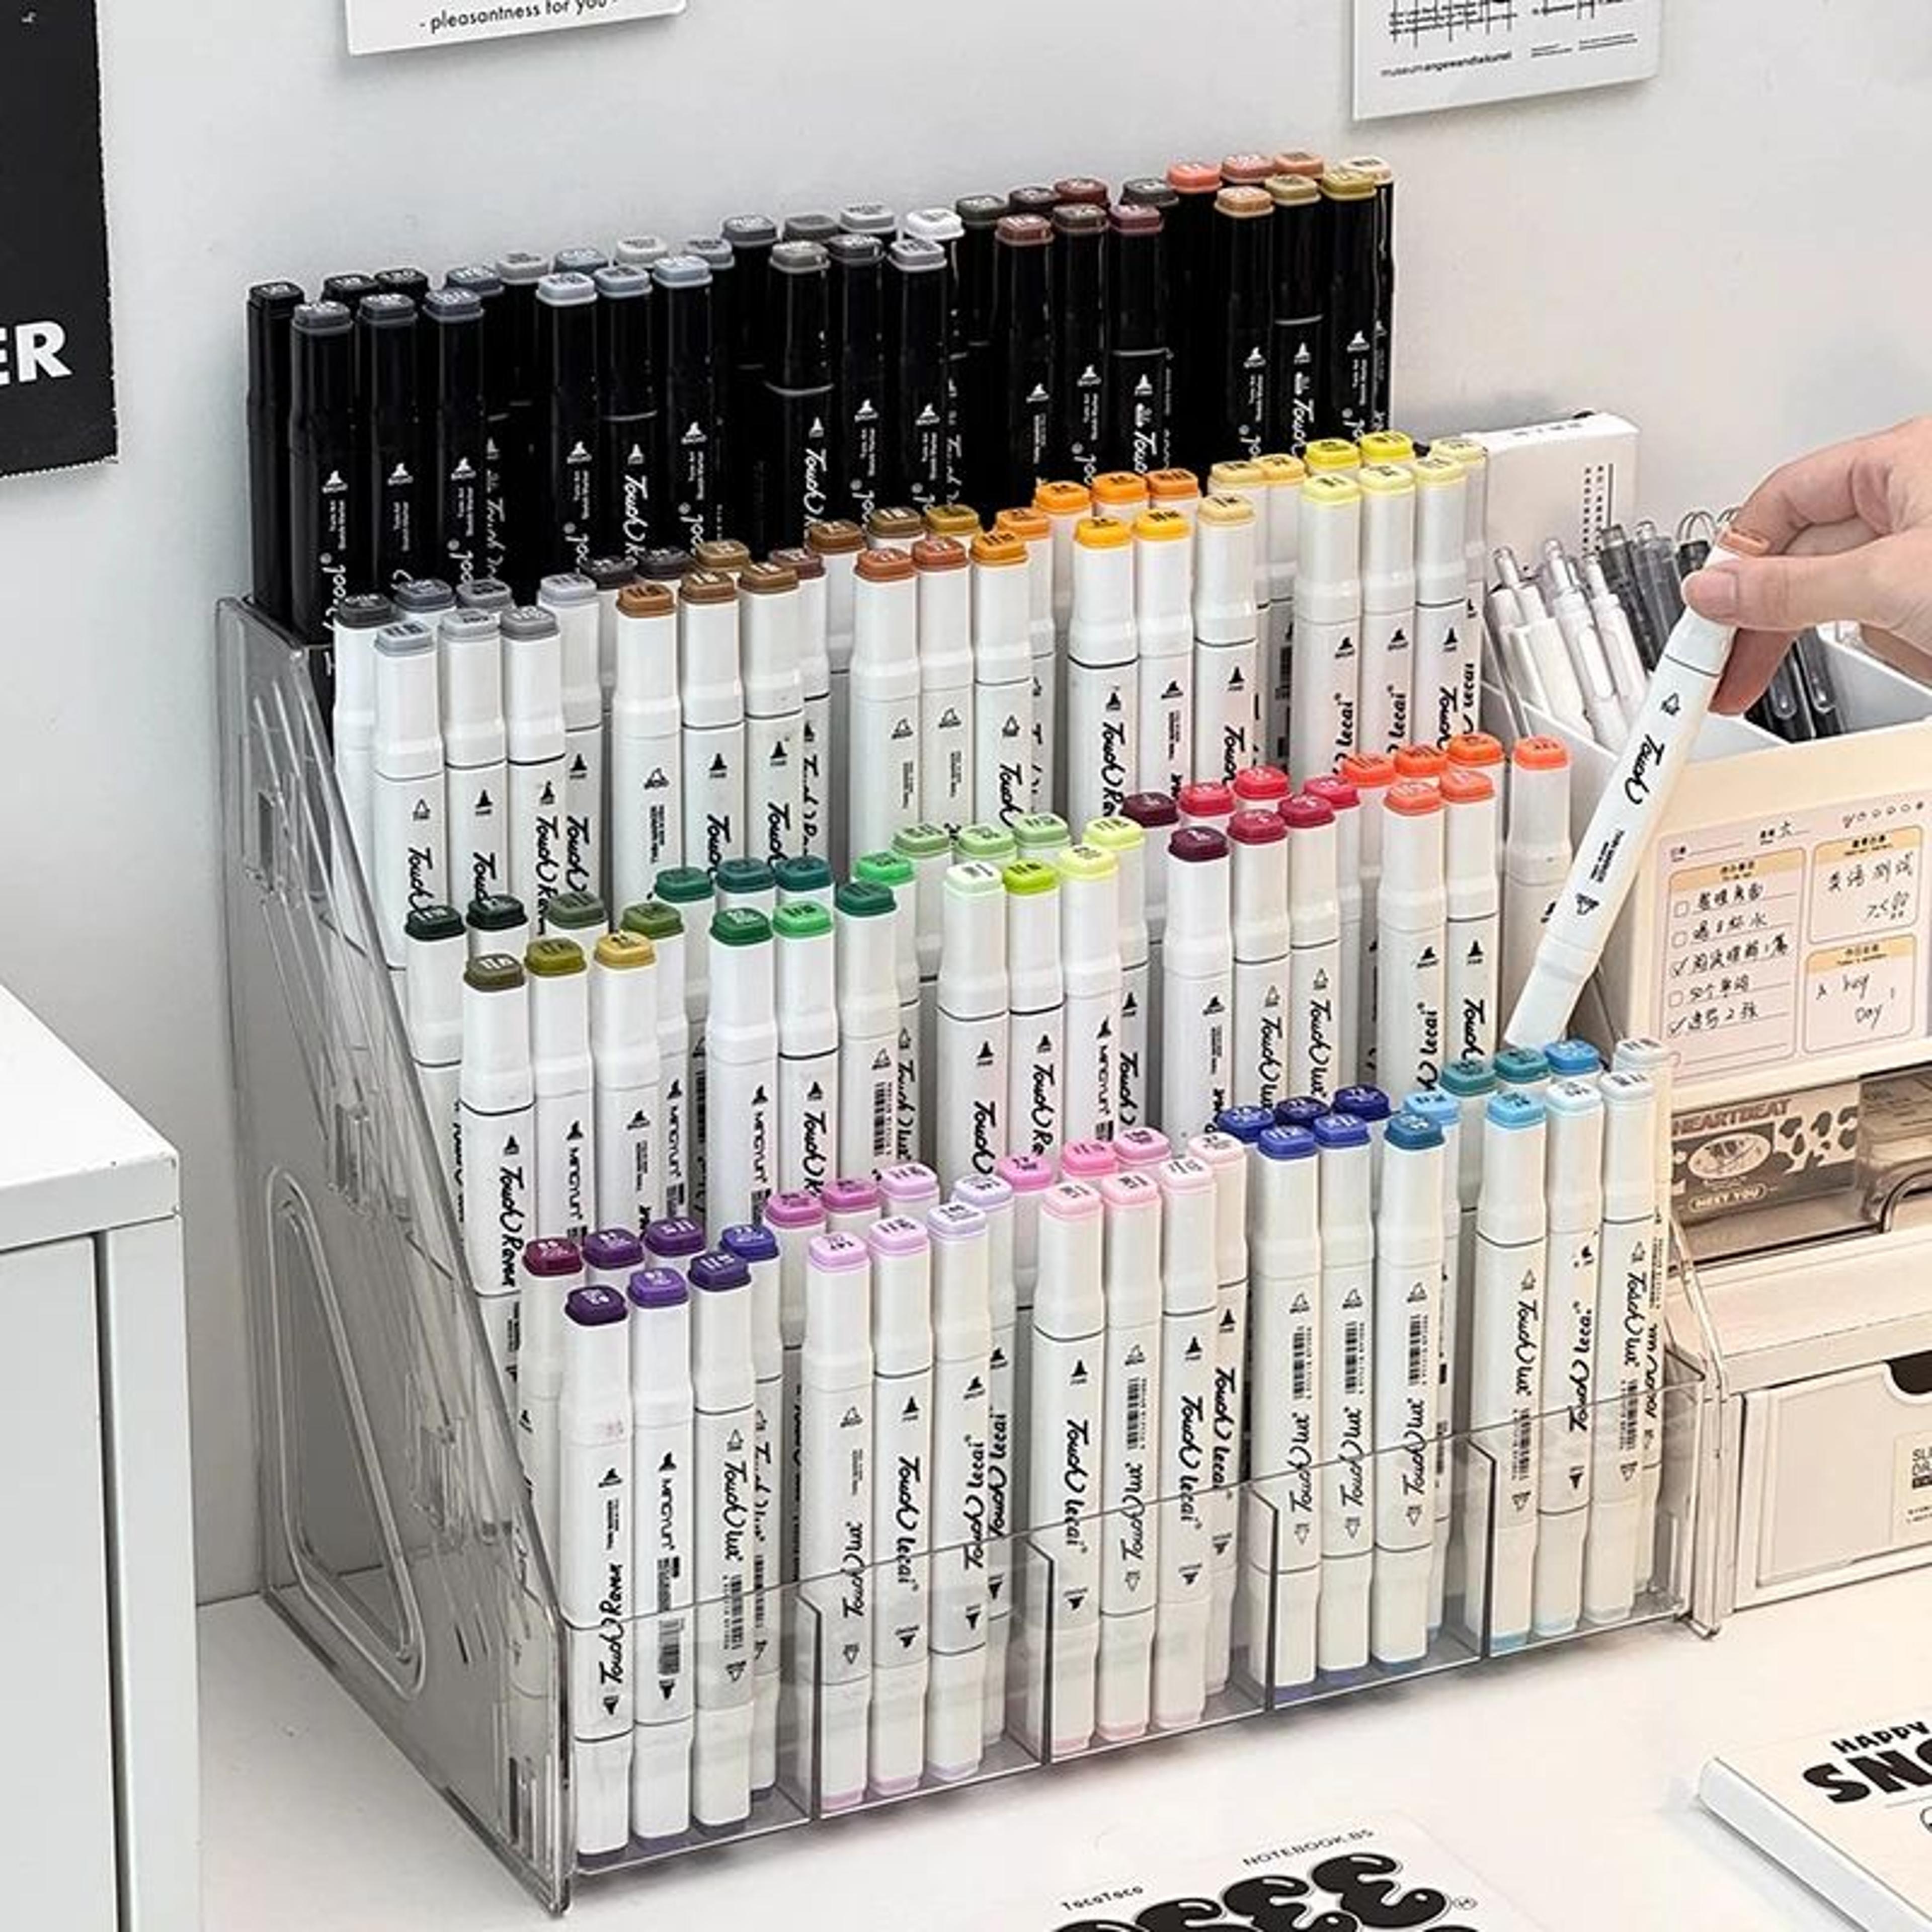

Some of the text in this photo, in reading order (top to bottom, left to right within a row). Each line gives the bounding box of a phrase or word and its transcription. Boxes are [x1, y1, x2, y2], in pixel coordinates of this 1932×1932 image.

[431, 4, 540, 33] pleasantness
[545, 1, 569, 15] for
[576, 0, 607, 15] you
[624, 474, 648, 541] Touch
[1101, 721, 1126, 786] Touch
[1625, 734, 1665, 805] Touch
[472, 852, 496, 906] Touc
[536, 816, 559, 881] Touch
[566, 815, 591, 892] Touch
[1258, 1016, 1283, 1089] Touch
[1309, 999, 1332, 1071] Touch
[1031, 1064, 1055, 1128] Touch
[803, 1111, 827, 1178] Touch
[973, 1100, 996, 1175] Touch
[500, 1166, 525, 1232] Touch
[1515, 1299, 1539, 1364] Touch
[1212, 1367, 1236, 1441] Touch
[1569, 1360, 1590, 1433] Touch
[1065, 1419, 1090, 1494] Touch
[1179, 1395, 1204, 1469] Touch
[1402, 1431, 1427, 1495] Touch
[723, 1461, 748, 1527] Touch
[896, 1456, 920, 1532] Touch
[1287, 1447, 1313, 1512] Touch
[1338, 1445, 1363, 1507] Touch
[962, 1494, 986, 1570] Touch
[599, 1618, 624, 1685] Touch
[1830, 1721, 1930, 1754] HAPPY
